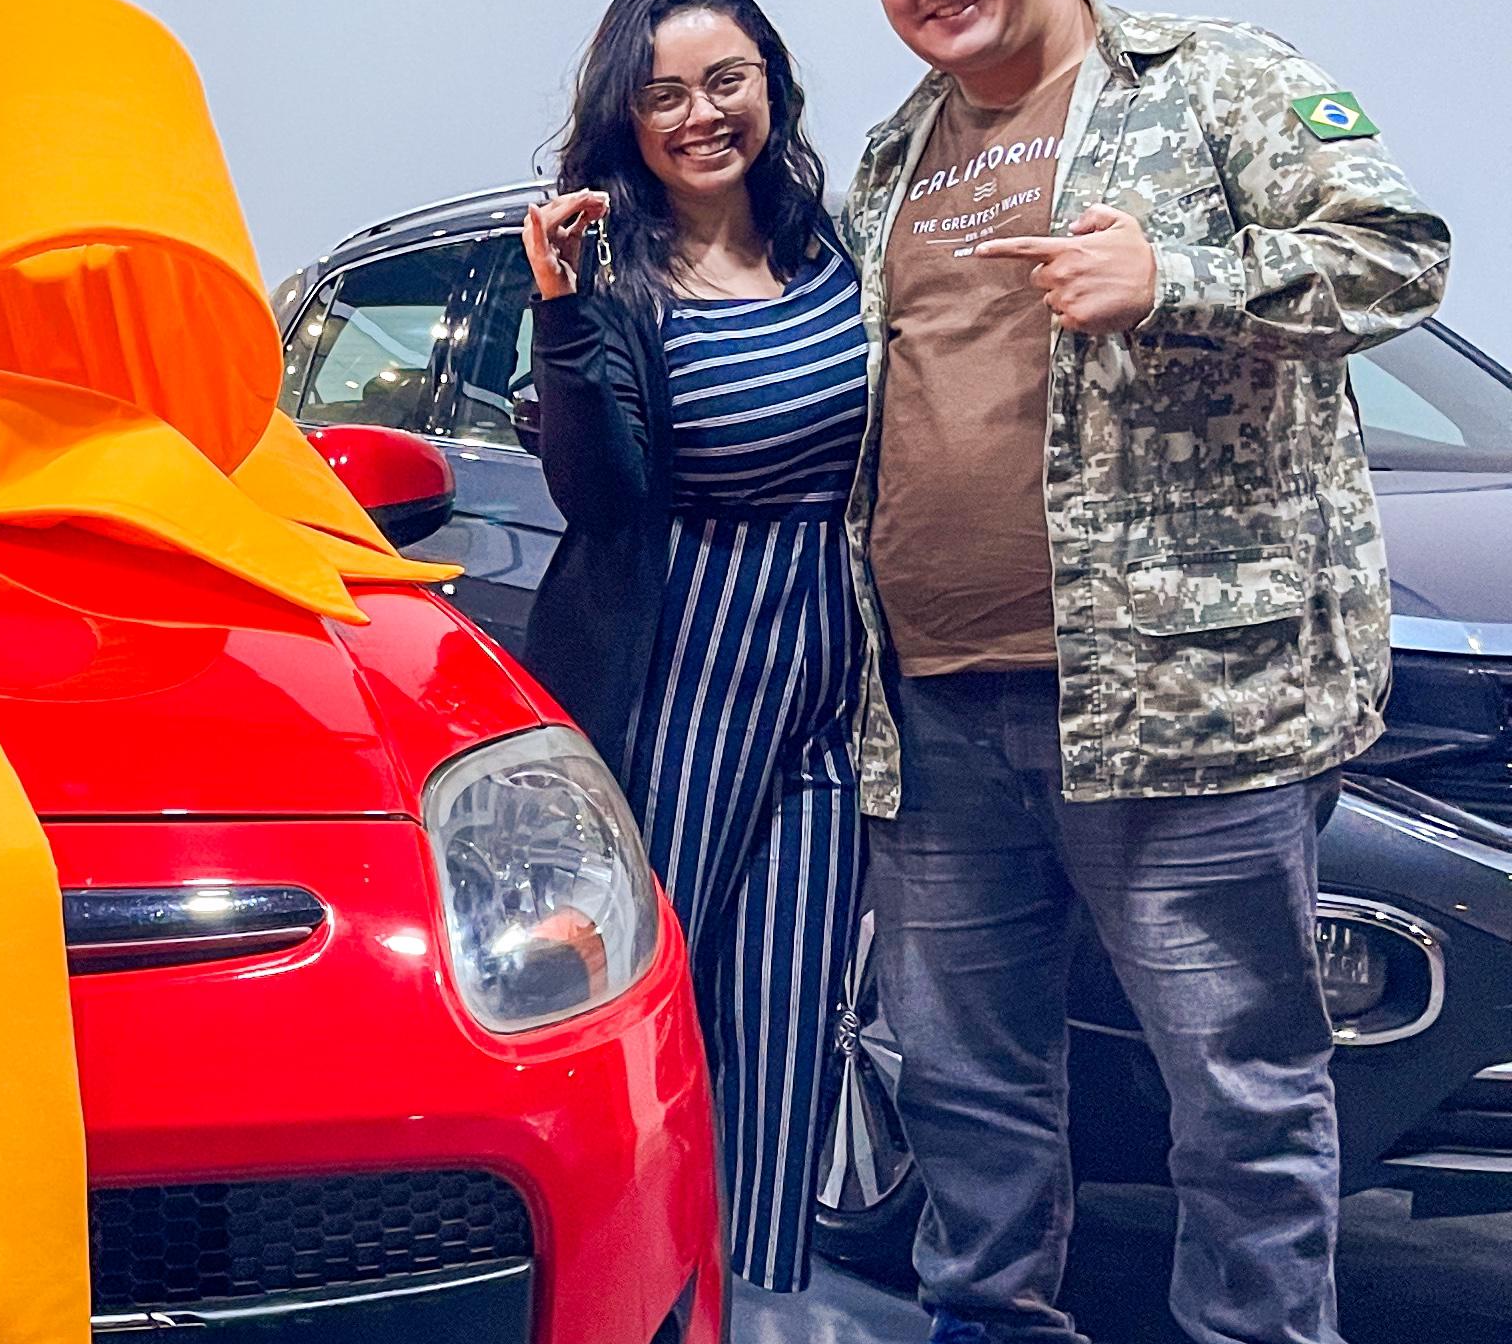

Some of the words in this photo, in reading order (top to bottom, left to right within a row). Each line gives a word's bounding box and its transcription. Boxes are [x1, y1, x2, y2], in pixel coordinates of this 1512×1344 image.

[912, 219, 938, 234] THE
[941, 204, 1000, 231] GREATEST
[1001, 187, 1041, 212] WAVES
